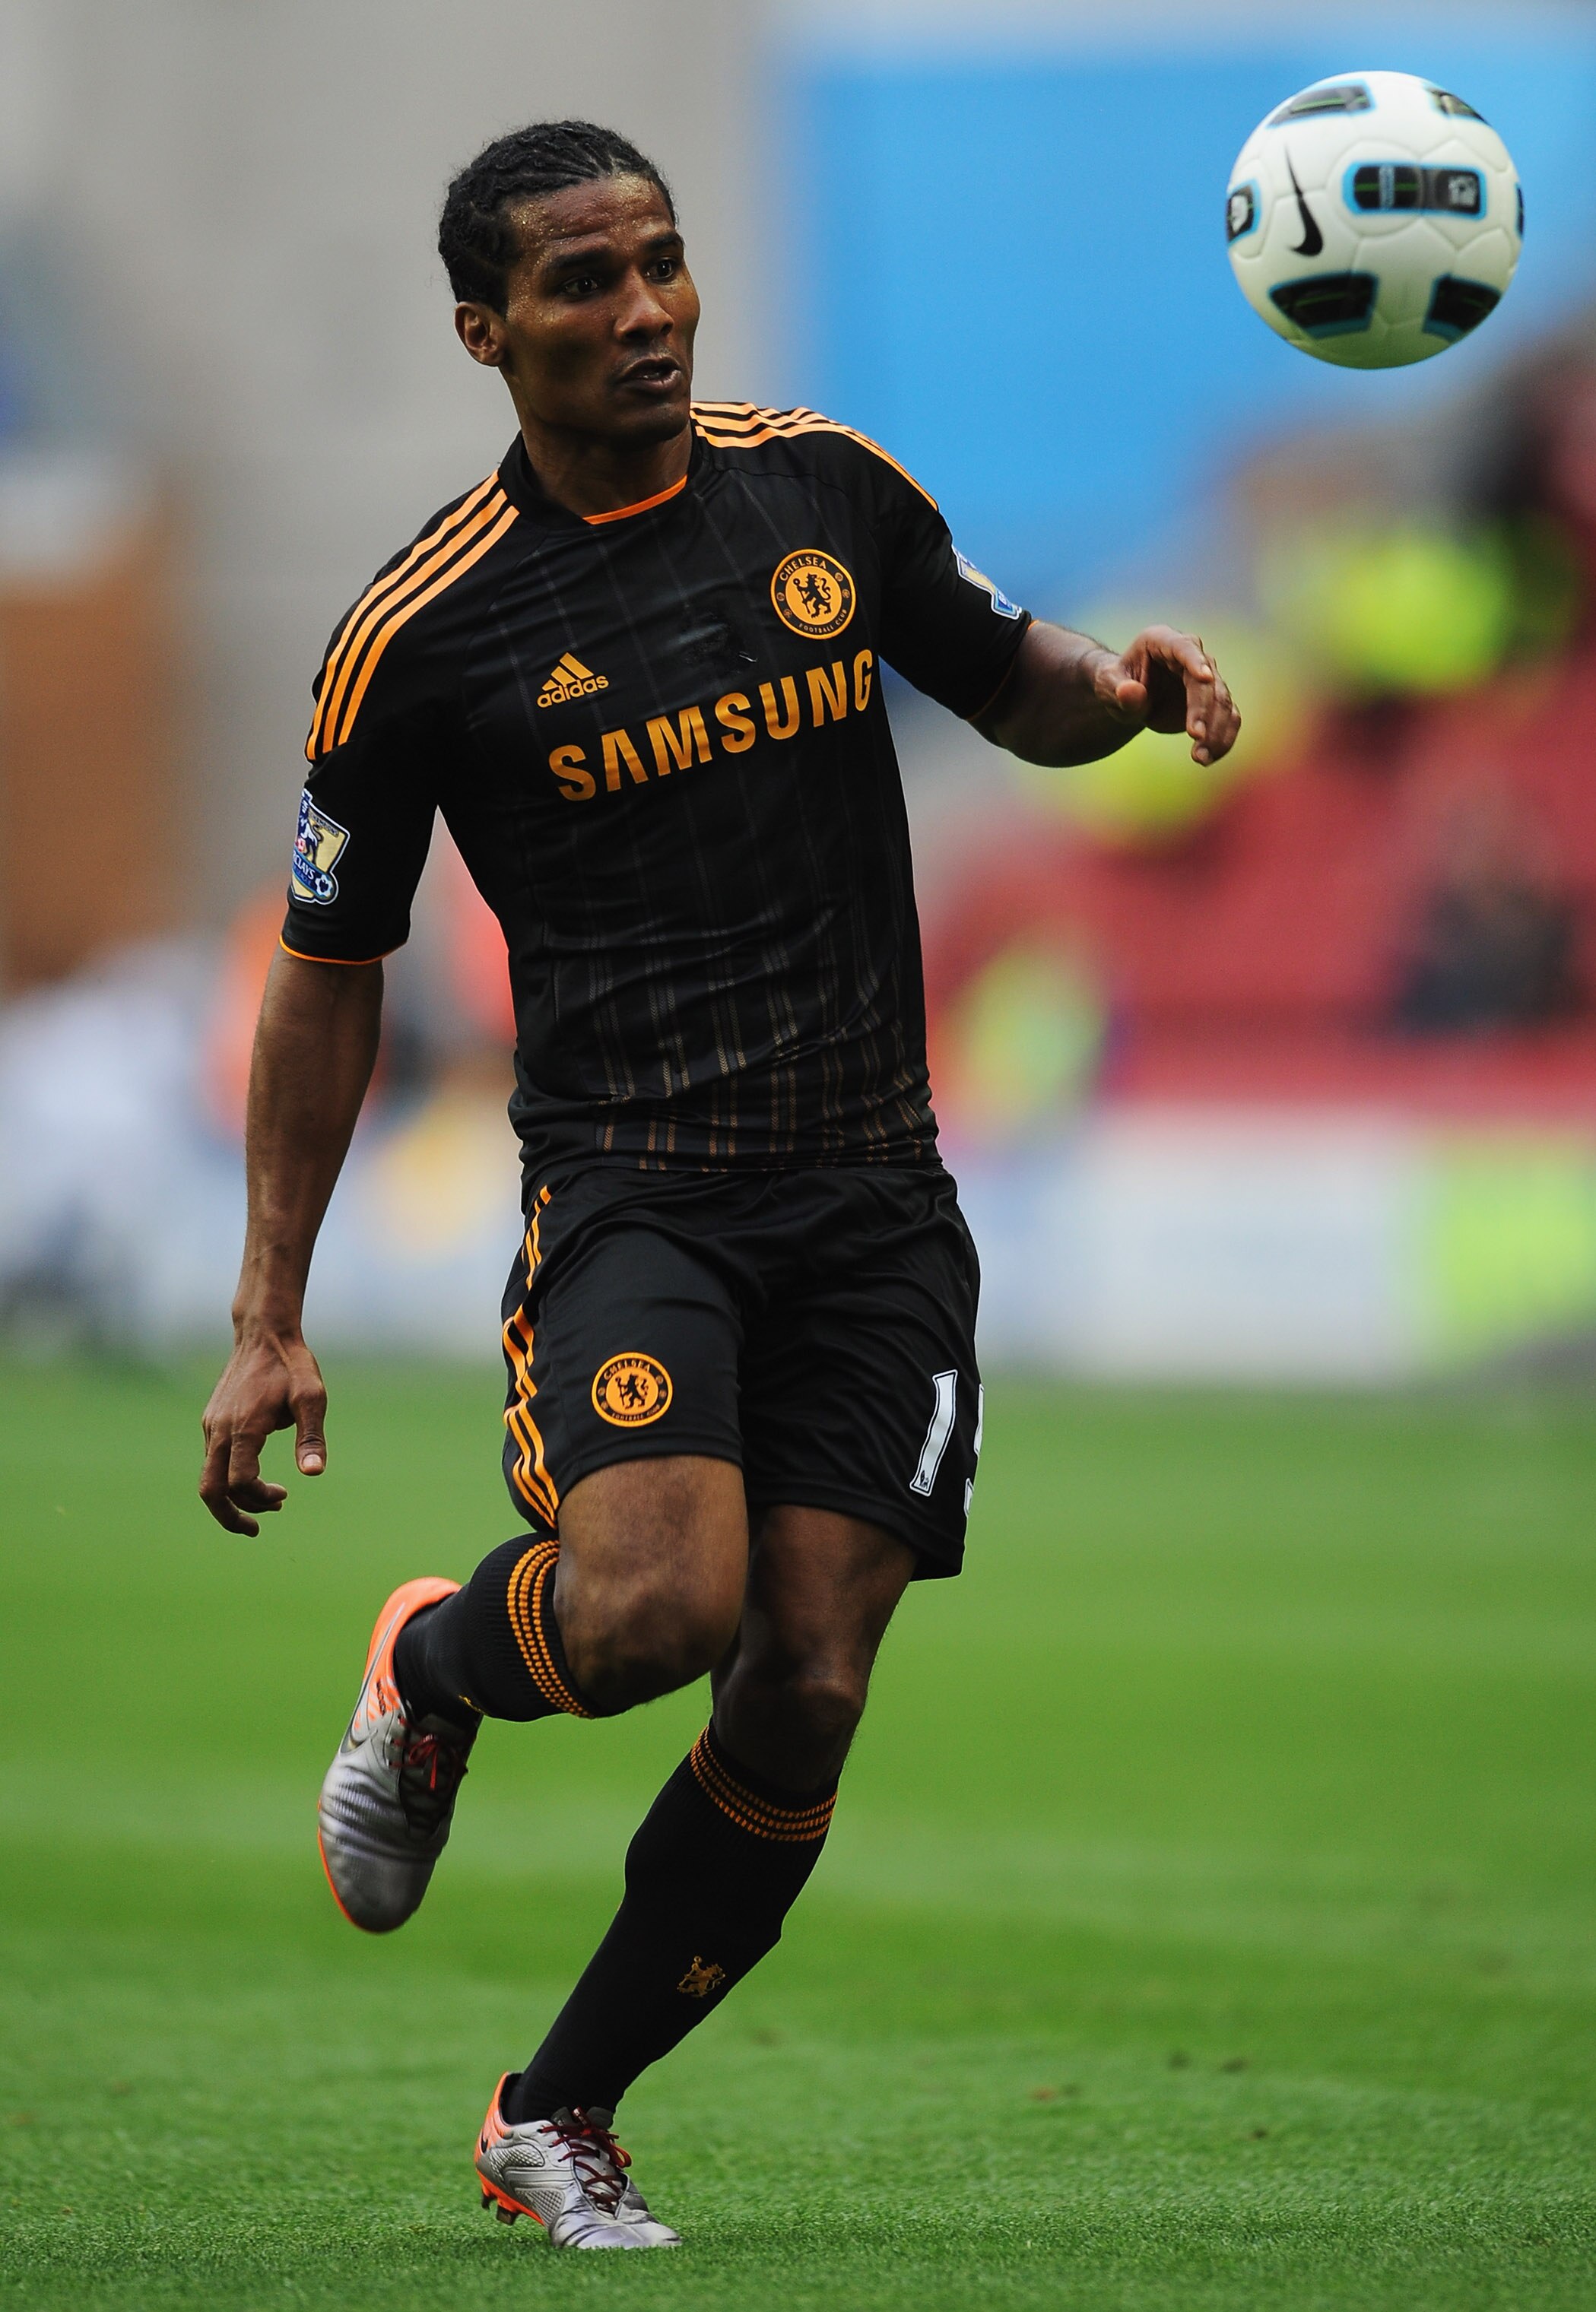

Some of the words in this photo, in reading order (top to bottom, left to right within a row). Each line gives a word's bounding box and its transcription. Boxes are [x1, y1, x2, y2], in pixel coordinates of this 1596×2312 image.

[779, 557, 827, 581] CHELSEA
[798, 623, 834, 634] FOOTBALL
[835, 609, 848, 626] CLUB
[537, 674, 609, 709] adidas
[548, 649, 873, 801] SAMSUNG
[604, 1359, 650, 1380] CHELSEA
